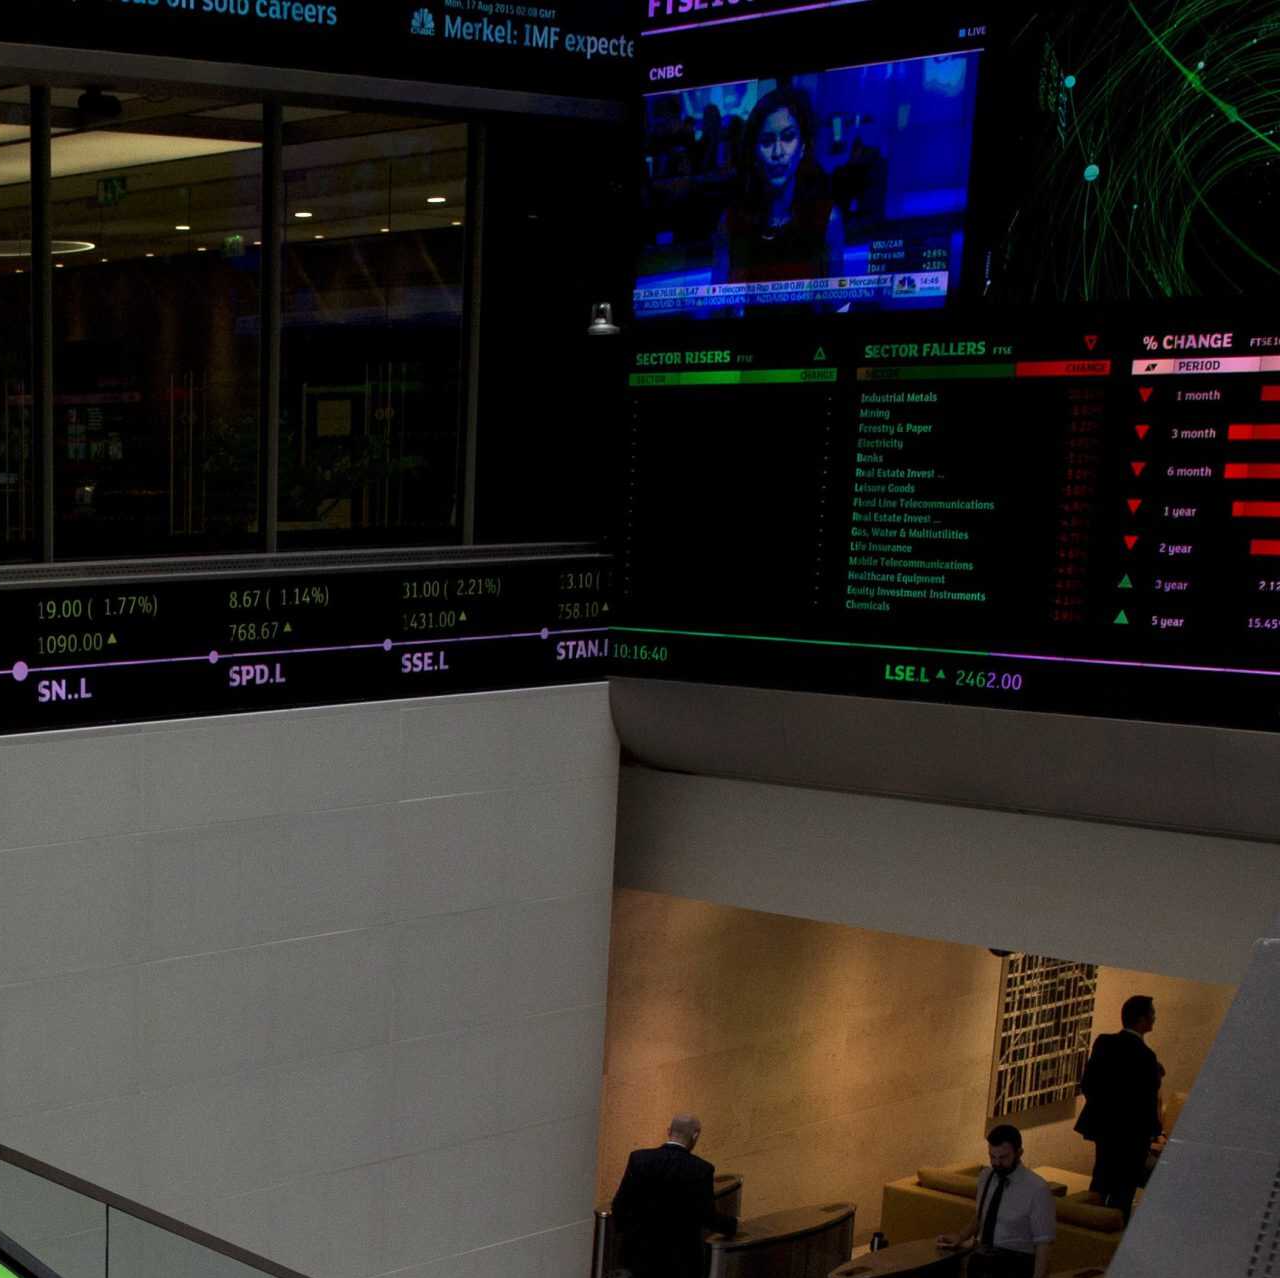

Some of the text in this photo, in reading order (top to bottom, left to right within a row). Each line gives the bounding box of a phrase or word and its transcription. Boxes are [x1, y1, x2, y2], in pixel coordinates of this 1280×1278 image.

[255, 0, 337, 25] careers
[445, 15, 519, 45] Merkel:
[524, 23, 560, 49] IMF
[968, 25, 987, 37] LIVE
[649, 64, 684, 80] CNBC
[1143, 333, 1280, 351] % CHANGE FTSE1
[864, 343, 919, 359] SECTOR
[922, 340, 987, 357] FALLERS
[635, 352, 682, 366] SECTOR
[685, 350, 731, 364] RISERS
[1179, 360, 1220, 371] PERIOD
[861, 391, 938, 403] Industrial Metals
[1176, 390, 1221, 401] 1 month
[859, 408, 891, 420] Mining
[906, 423, 933, 435] Paper
[1171, 428, 1216, 439] 3 month
[878, 468, 905, 478] Estate
[907, 469, 935, 479] Invest
[1167, 466, 1212, 477] 6 month
[899, 499, 995, 510] Telecommunications
[905, 514, 932, 524] Invest
[1163, 507, 1197, 520] 1 year
[1159, 543, 1193, 556] 2 year
[880, 558, 974, 571] Telecommunications
[456, 575, 503, 597] 2.21%)
[897, 573, 945, 586] Equipment
[1164, 581, 1188, 592] year
[229, 589, 261, 609] 8.67
[279, 584, 329, 607] 1.14%)
[876, 587, 928, 599] Investment
[929, 590, 986, 602] Instruments
[37, 598, 83, 620] 19.00
[103, 594, 158, 617] 1.77%)
[845, 600, 891, 612] Chemicals
[1151, 616, 1185, 629] 5 year
[1248, 617, 1280, 629] 15.45
[228, 621, 279, 642] 768.67
[37, 632, 103, 655] 1090.00
[613, 643, 668, 662] 10:16:40
[400, 651, 449, 674] SSE.L
[228, 663, 286, 687] SPD.L
[885, 663, 1022, 690] LSE.L 2462.00
[37, 677, 92, 703] SN..L
